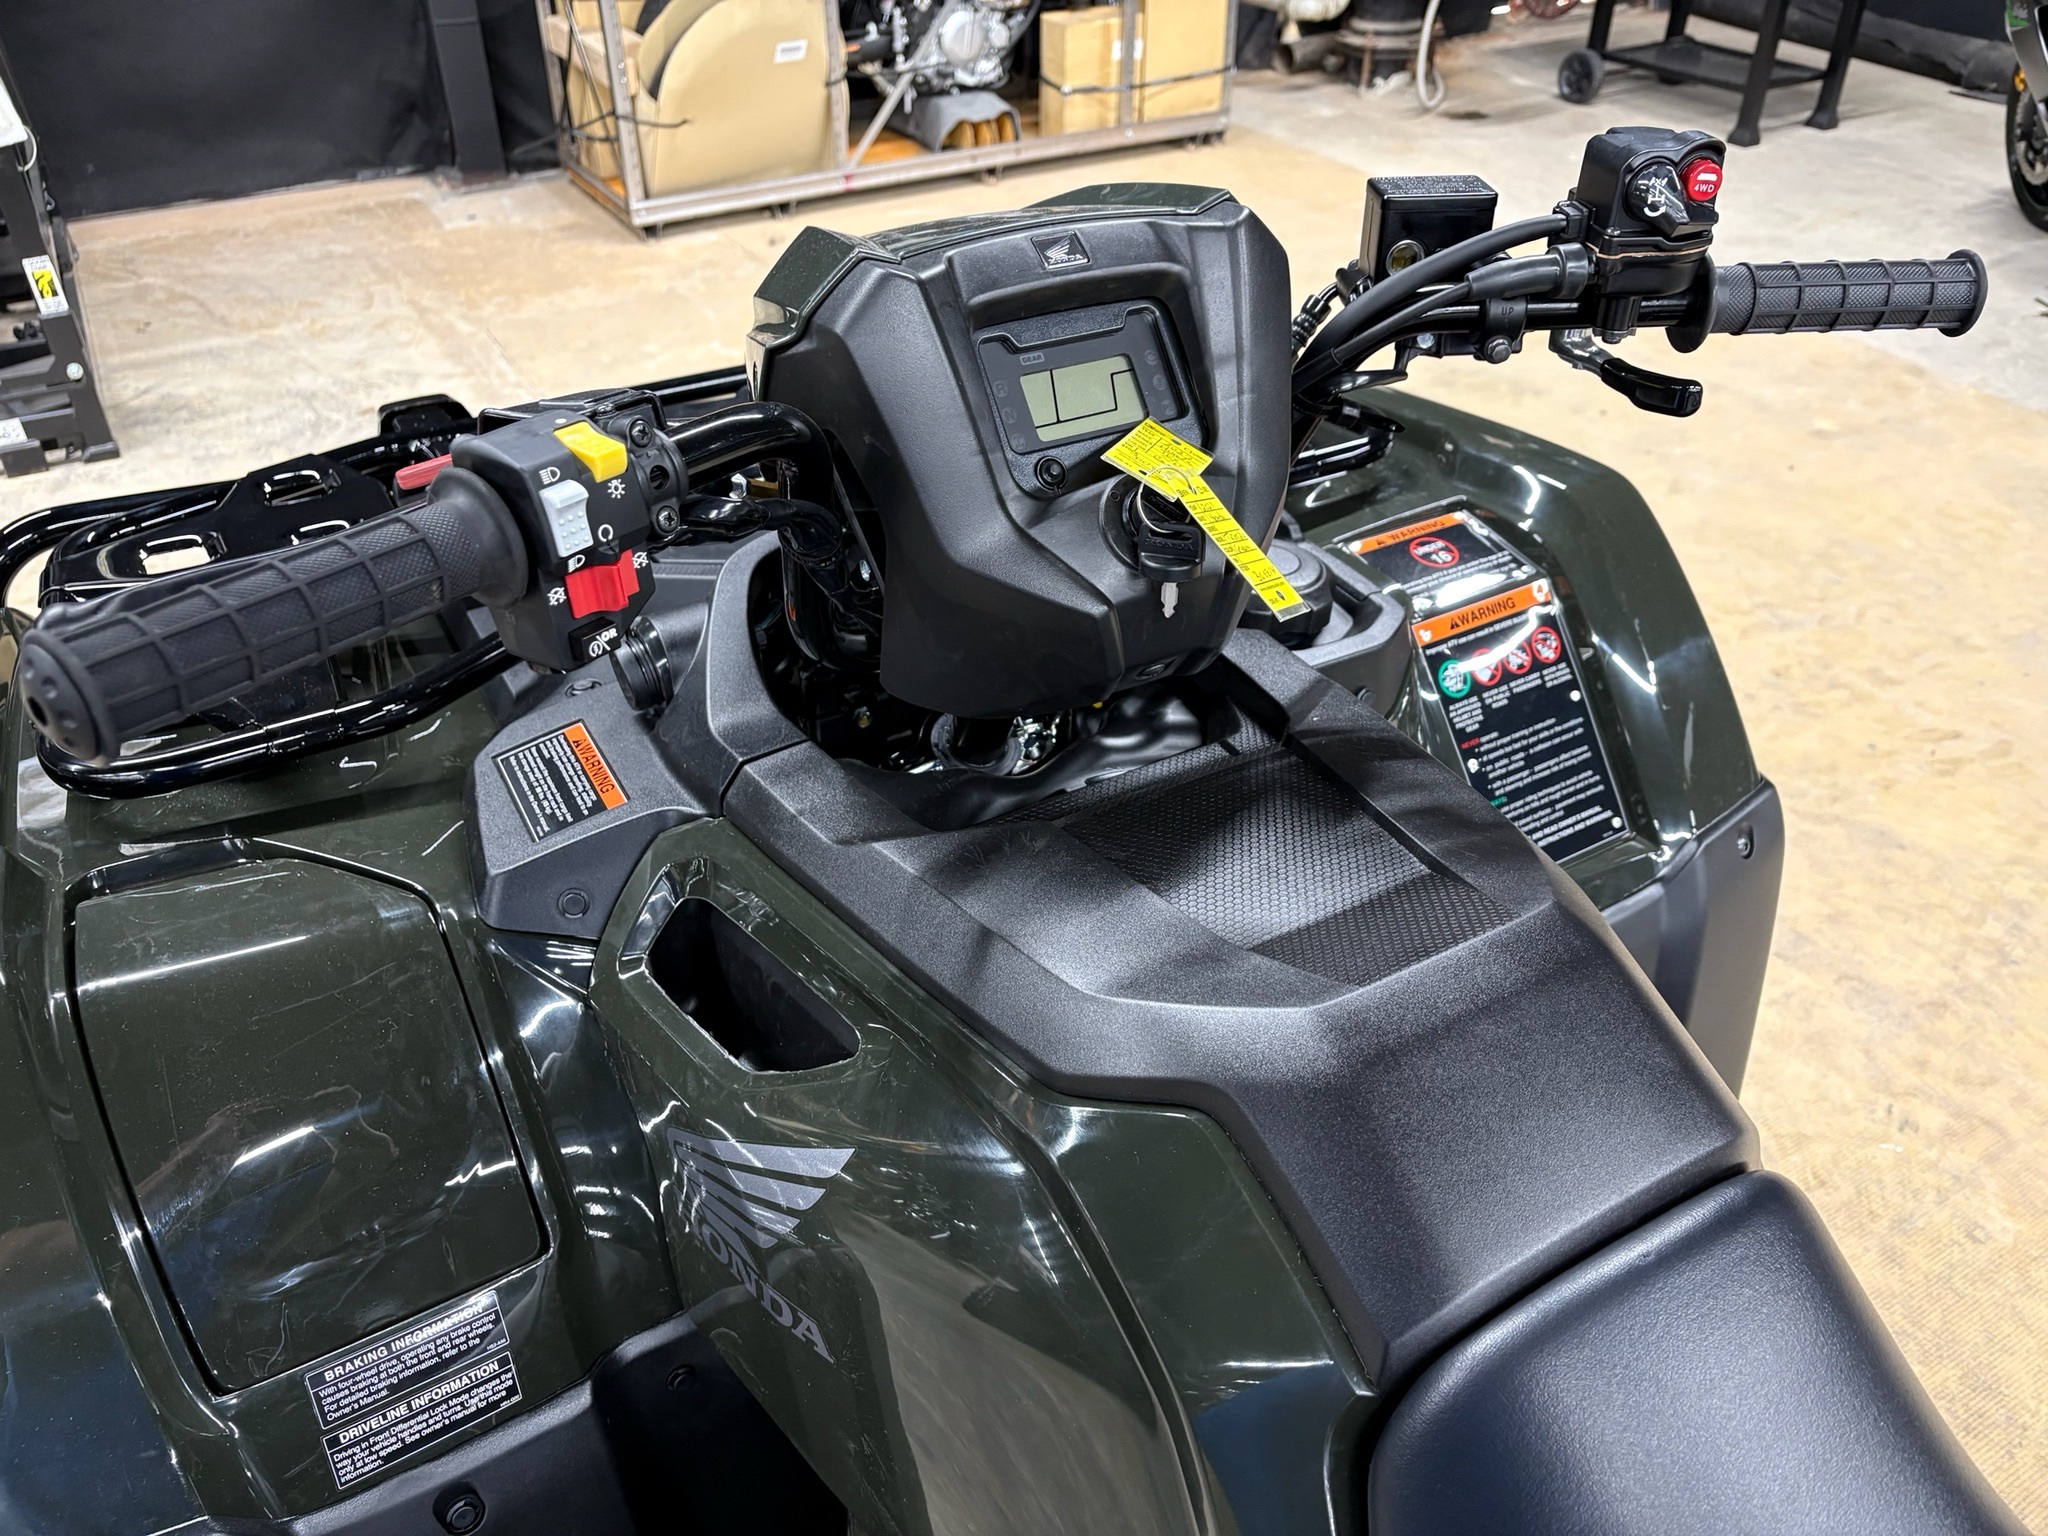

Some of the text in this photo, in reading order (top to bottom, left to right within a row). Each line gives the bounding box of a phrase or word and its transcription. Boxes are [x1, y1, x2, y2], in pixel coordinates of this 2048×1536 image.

[1694, 184, 1715, 193] 4WD
[1502, 306, 1515, 316] UP
[1022, 354, 1043, 363] GEAR
[1413, 540, 1446, 556] UNDER
[1431, 551, 1453, 564] 16
[601, 628, 617, 641] OR
[1458, 597, 1516, 626] WARNING
[577, 743, 615, 794] WARNING
[676, 1188, 835, 1364] HONDA
[318, 1312, 496, 1398] With four-wheel drive, operating any brake control
[321, 1322, 495, 1408] causes braking at both the front and rear wheels.
[324, 1301, 484, 1382] BRAKING INFORMATION
[324, 1402, 338, 1416] For
[339, 1387, 369, 1407] detailed
[369, 1375, 398, 1393] braking
[398, 1356, 442, 1380] information,
[442, 1347, 459, 1360] refer
[459, 1343, 468, 1351] to
[468, 1337, 480, 1347] the
[339, 1360, 499, 1444] DRIVELINE INFORMATION
[327, 1388, 390, 1421] Owner's Manual.
[333, 1372, 512, 1462] Driving in Front Differential Lock Mode changes the
[335, 1379, 513, 1469] way your vehicle handles and turns. Use this mode
[338, 1464, 354, 1478] only
[355, 1459, 364, 1468] at
[363, 1453, 378, 1464] low
[378, 1440, 404, 1457] speed.
[404, 1433, 420, 1444] See
[421, 1418, 450, 1436] owner's
[450, 1403, 477, 1422] manual
[477, 1399, 487, 1409] for
[488, 1390, 507, 1403] more
[340, 1459, 384, 1483] information.
